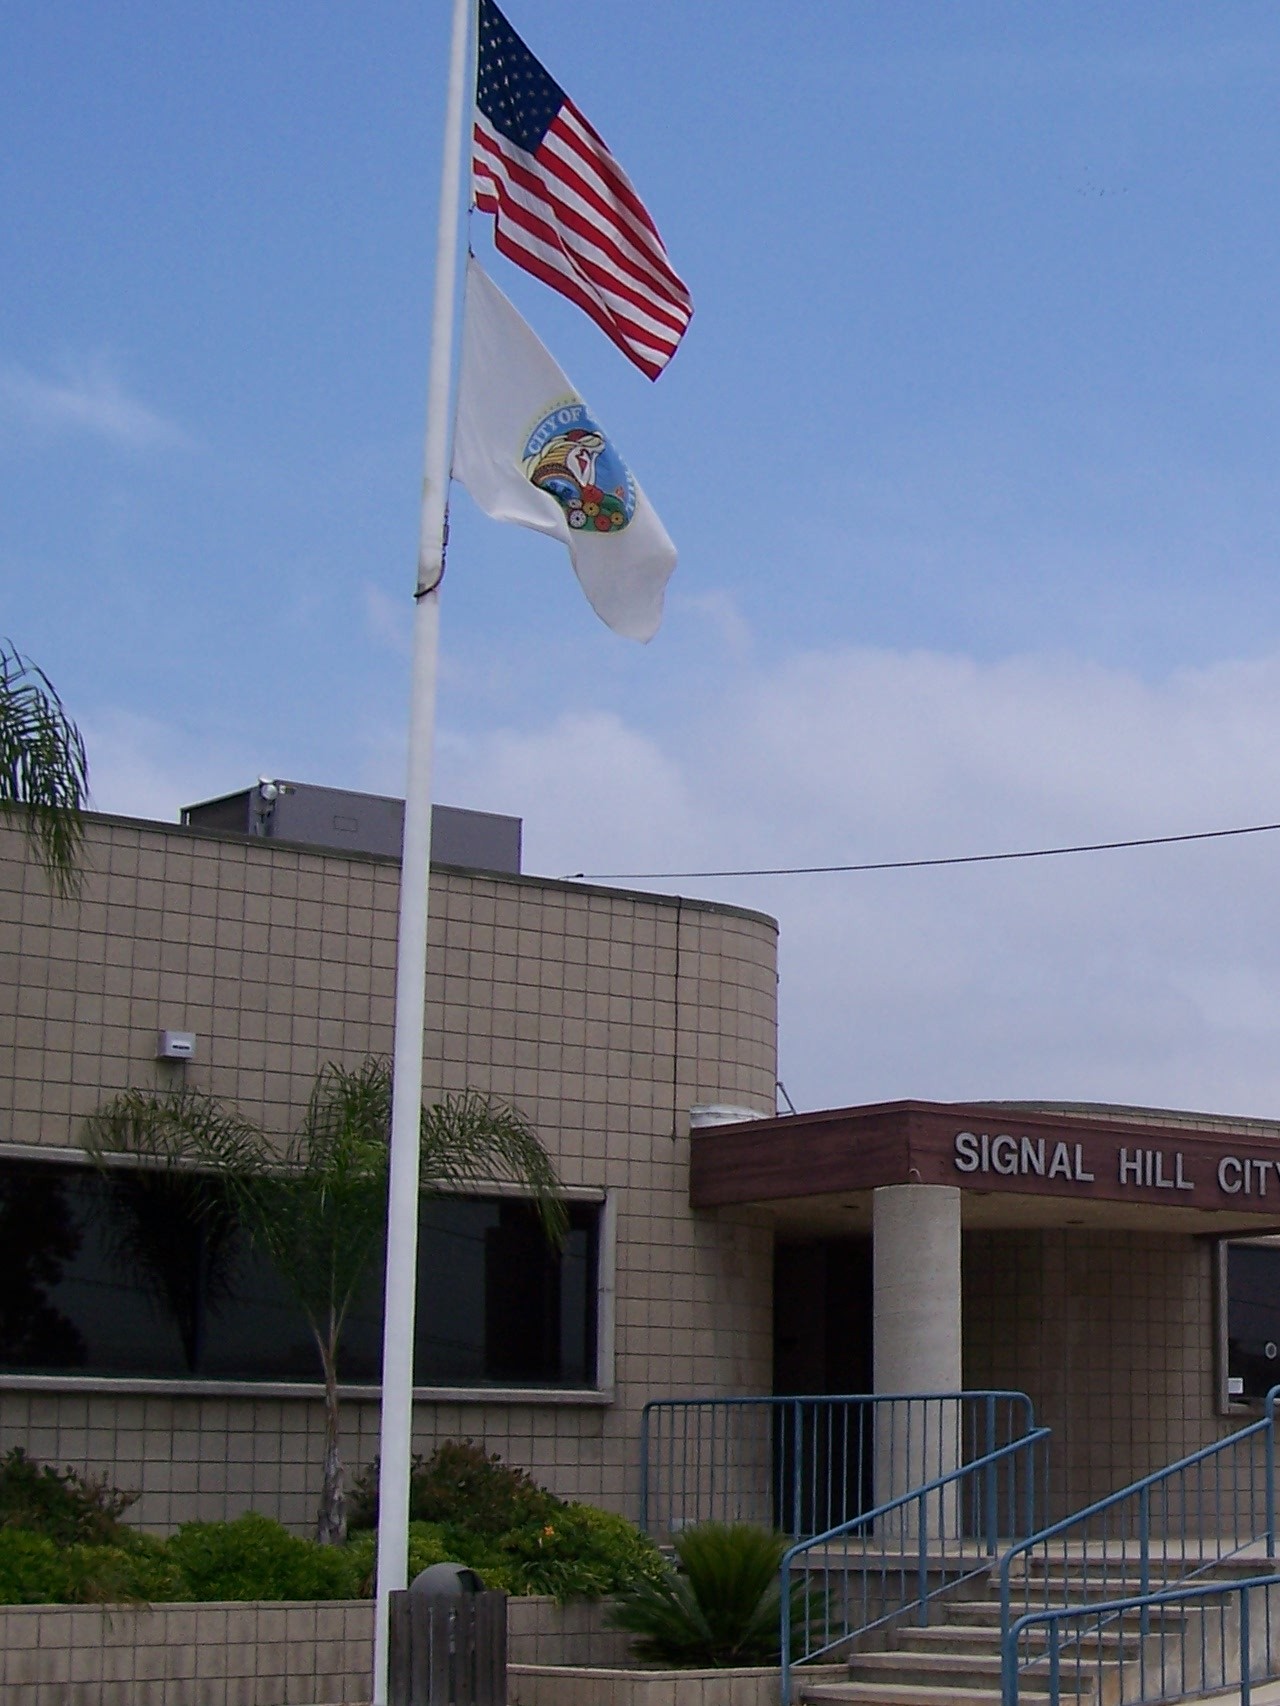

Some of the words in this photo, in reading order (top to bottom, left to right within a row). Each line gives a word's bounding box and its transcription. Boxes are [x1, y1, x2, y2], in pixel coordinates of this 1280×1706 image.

[528, 418, 558, 455] CITY
[559, 407, 583, 424] OF
[954, 1131, 1095, 1182] SIGNAL
[1119, 1147, 1195, 1190] HILL
